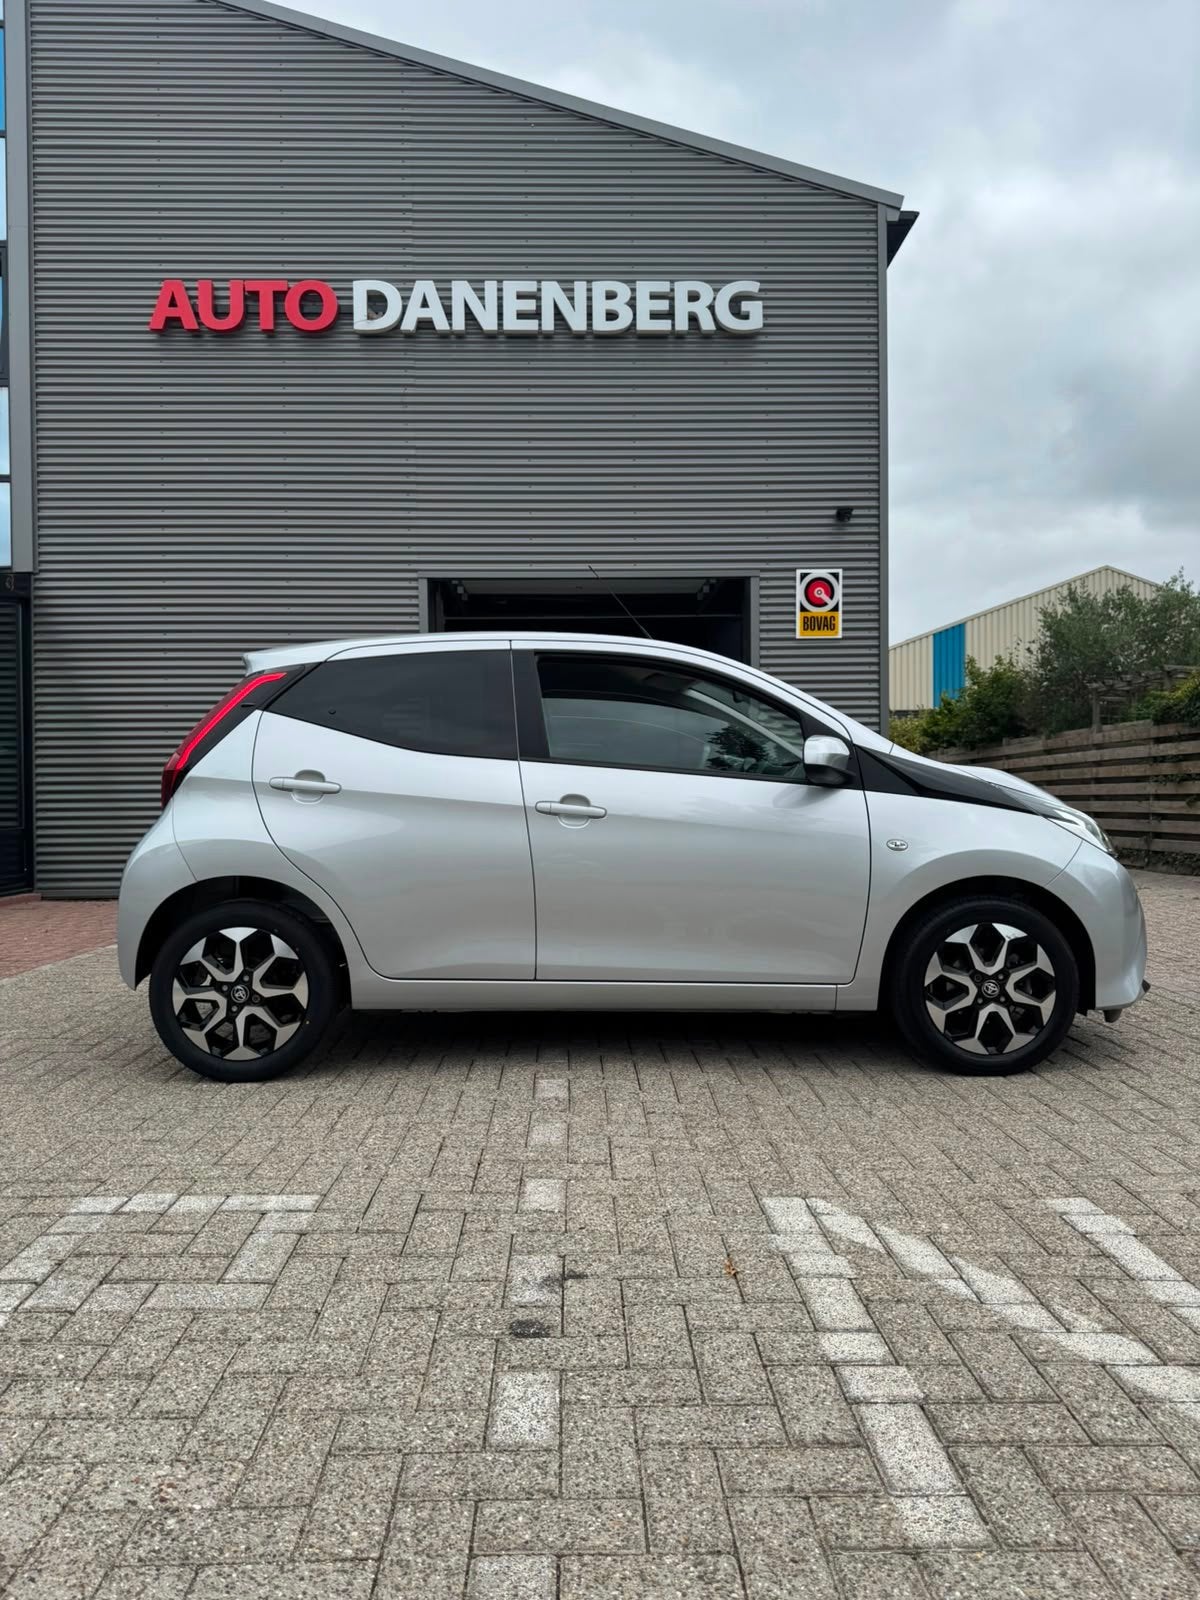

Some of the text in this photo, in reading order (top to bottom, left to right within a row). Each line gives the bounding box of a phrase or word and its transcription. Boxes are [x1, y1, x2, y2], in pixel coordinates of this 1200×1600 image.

[148, 279, 764, 336] AUTO DANENBERG
[802, 615, 836, 631] BOVAG
